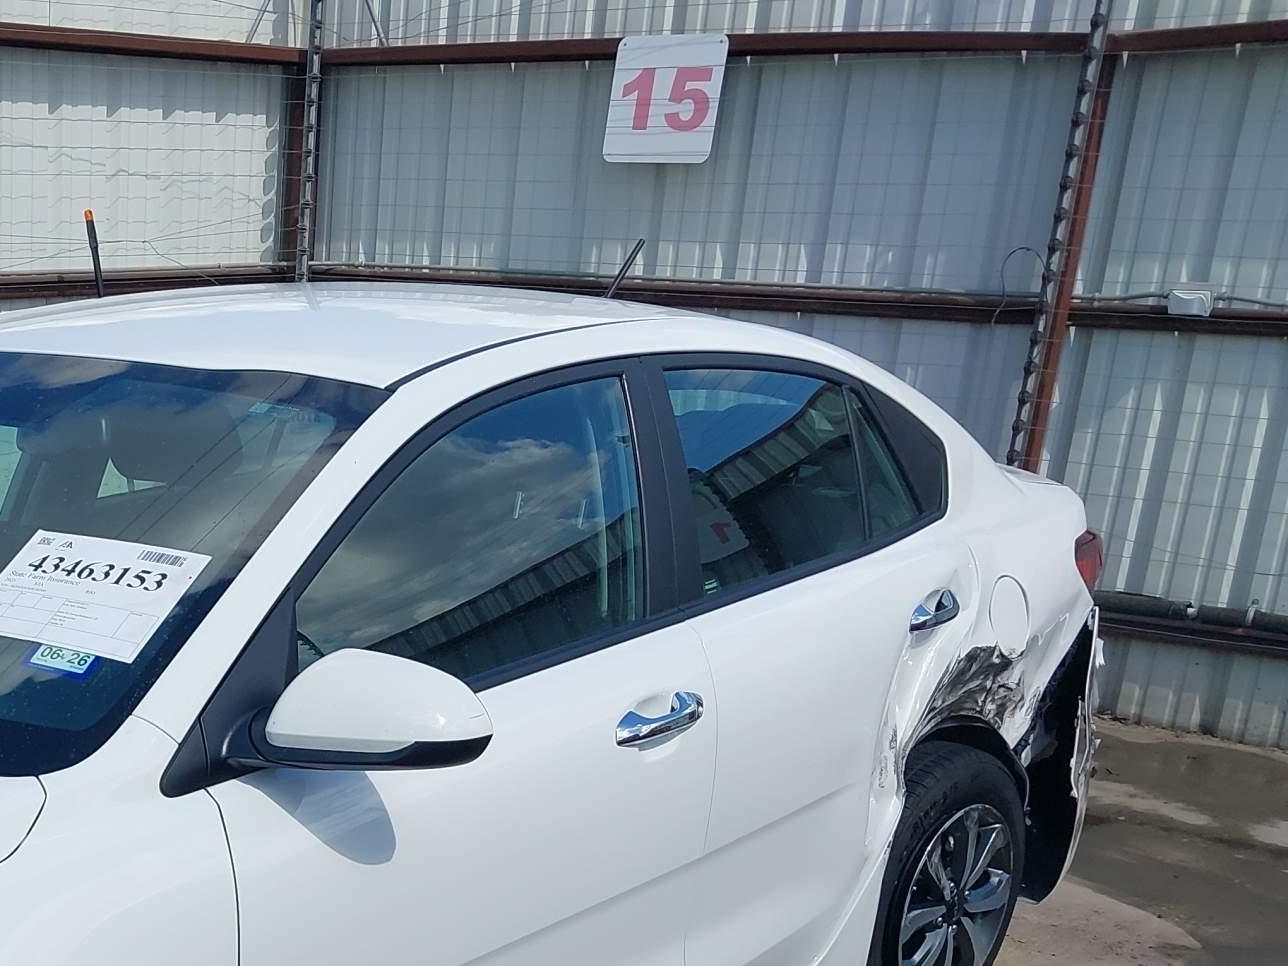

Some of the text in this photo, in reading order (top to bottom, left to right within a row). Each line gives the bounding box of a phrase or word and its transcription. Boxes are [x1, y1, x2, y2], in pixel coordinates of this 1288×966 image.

[622, 67, 714, 132] 15
[28, 554, 168, 592] 43463153
[40, 646, 63, 660] 06
[66, 652, 91, 667] 26
